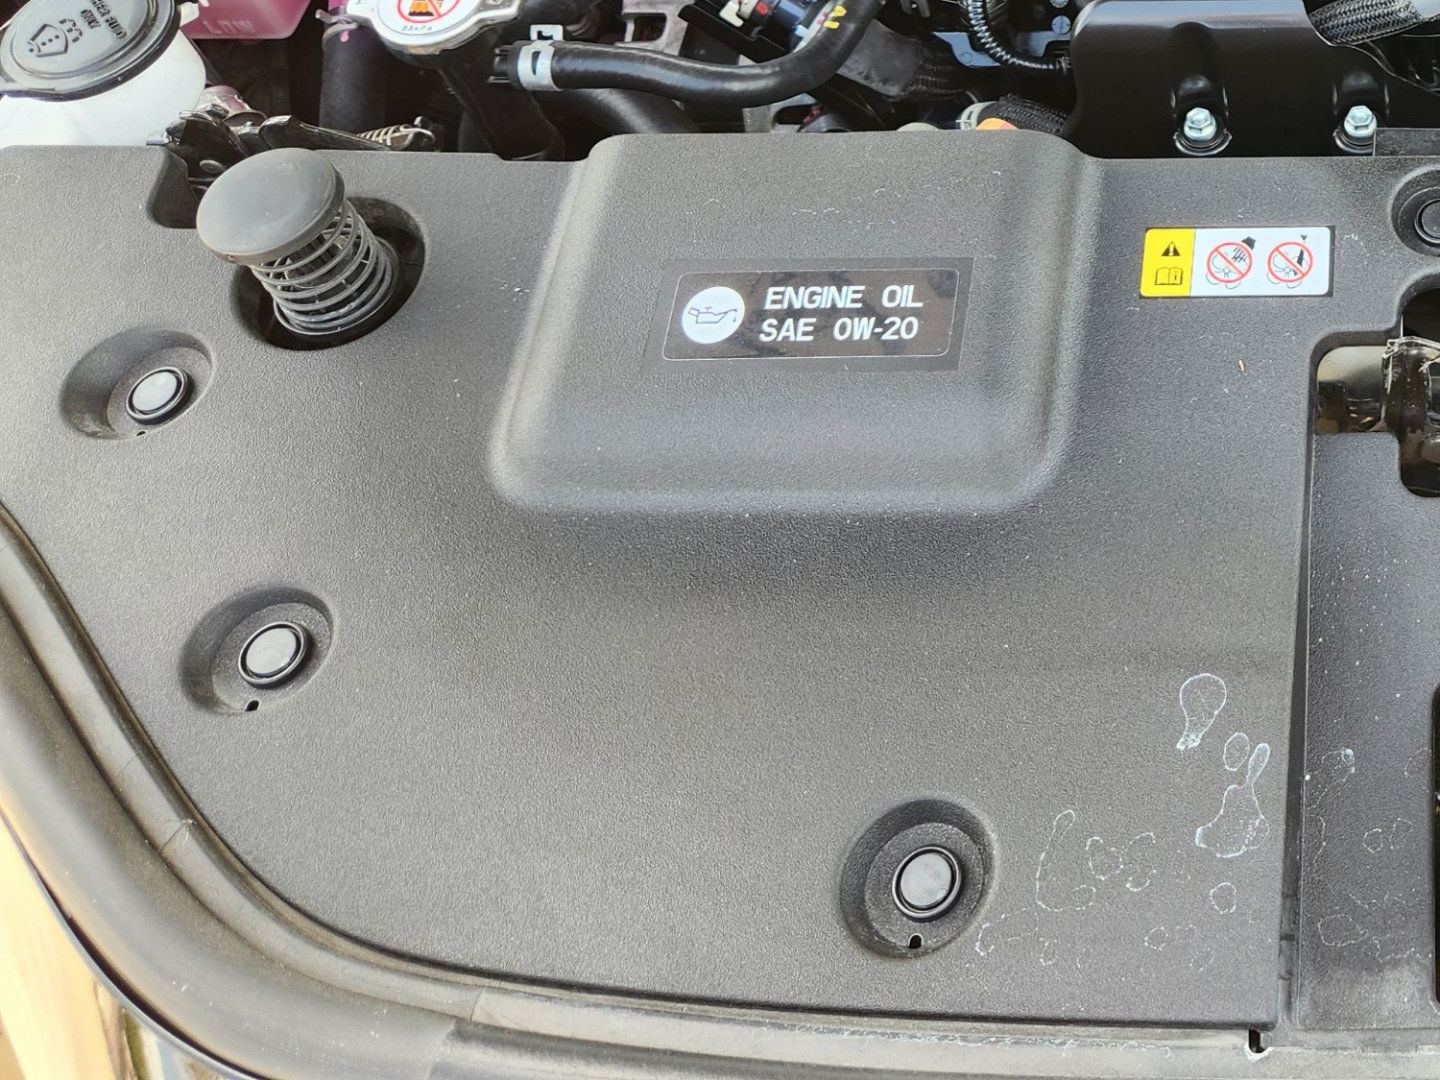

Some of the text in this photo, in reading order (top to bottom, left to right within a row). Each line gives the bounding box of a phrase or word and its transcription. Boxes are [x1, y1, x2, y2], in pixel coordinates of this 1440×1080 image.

[763, 284, 924, 310] ENGINE OIL
[759, 316, 919, 342] SAE 0W-20
